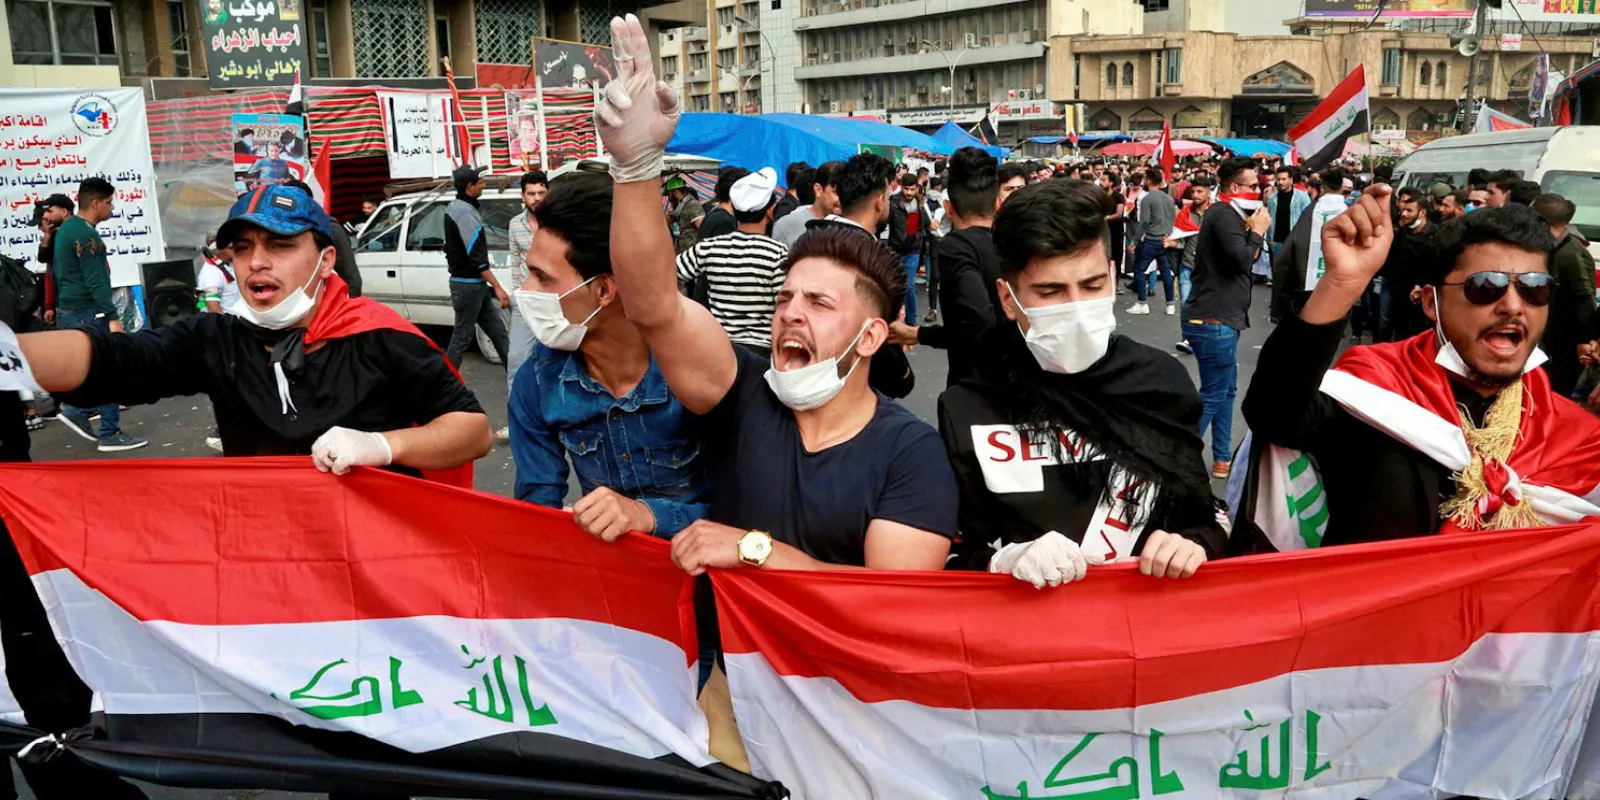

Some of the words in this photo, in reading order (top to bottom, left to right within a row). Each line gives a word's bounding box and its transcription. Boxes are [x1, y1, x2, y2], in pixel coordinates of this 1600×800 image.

[229, 0, 275, 22] موكب
[212, 27, 259, 53] الزهراء
[261, 23, 300, 52] أحباب
[217, 60, 243, 81] دشير
[245, 59, 262, 79] أبو
[0, 115, 15, 131] اكب
[17, 114, 48, 127] اقامة
[18, 134, 52, 150] سيكون
[55, 135, 82, 151] الذي
[400, 145, 424, 157] الحرية
[16, 157, 41, 171] مع
[44, 154, 87, 169] بالتعاون
[12, 172, 53, 188] الشهداء
[116, 169, 142, 183] وذلك
[11, 193, 31, 212] في
[119, 187, 147, 203] الثورة
[127, 206, 144, 223] في
[118, 225, 152, 240] السلمية
[106, 245, 129, 256] ساح
[453, 645, 558, 727] الله
[1219, 708, 1332, 790] الله
